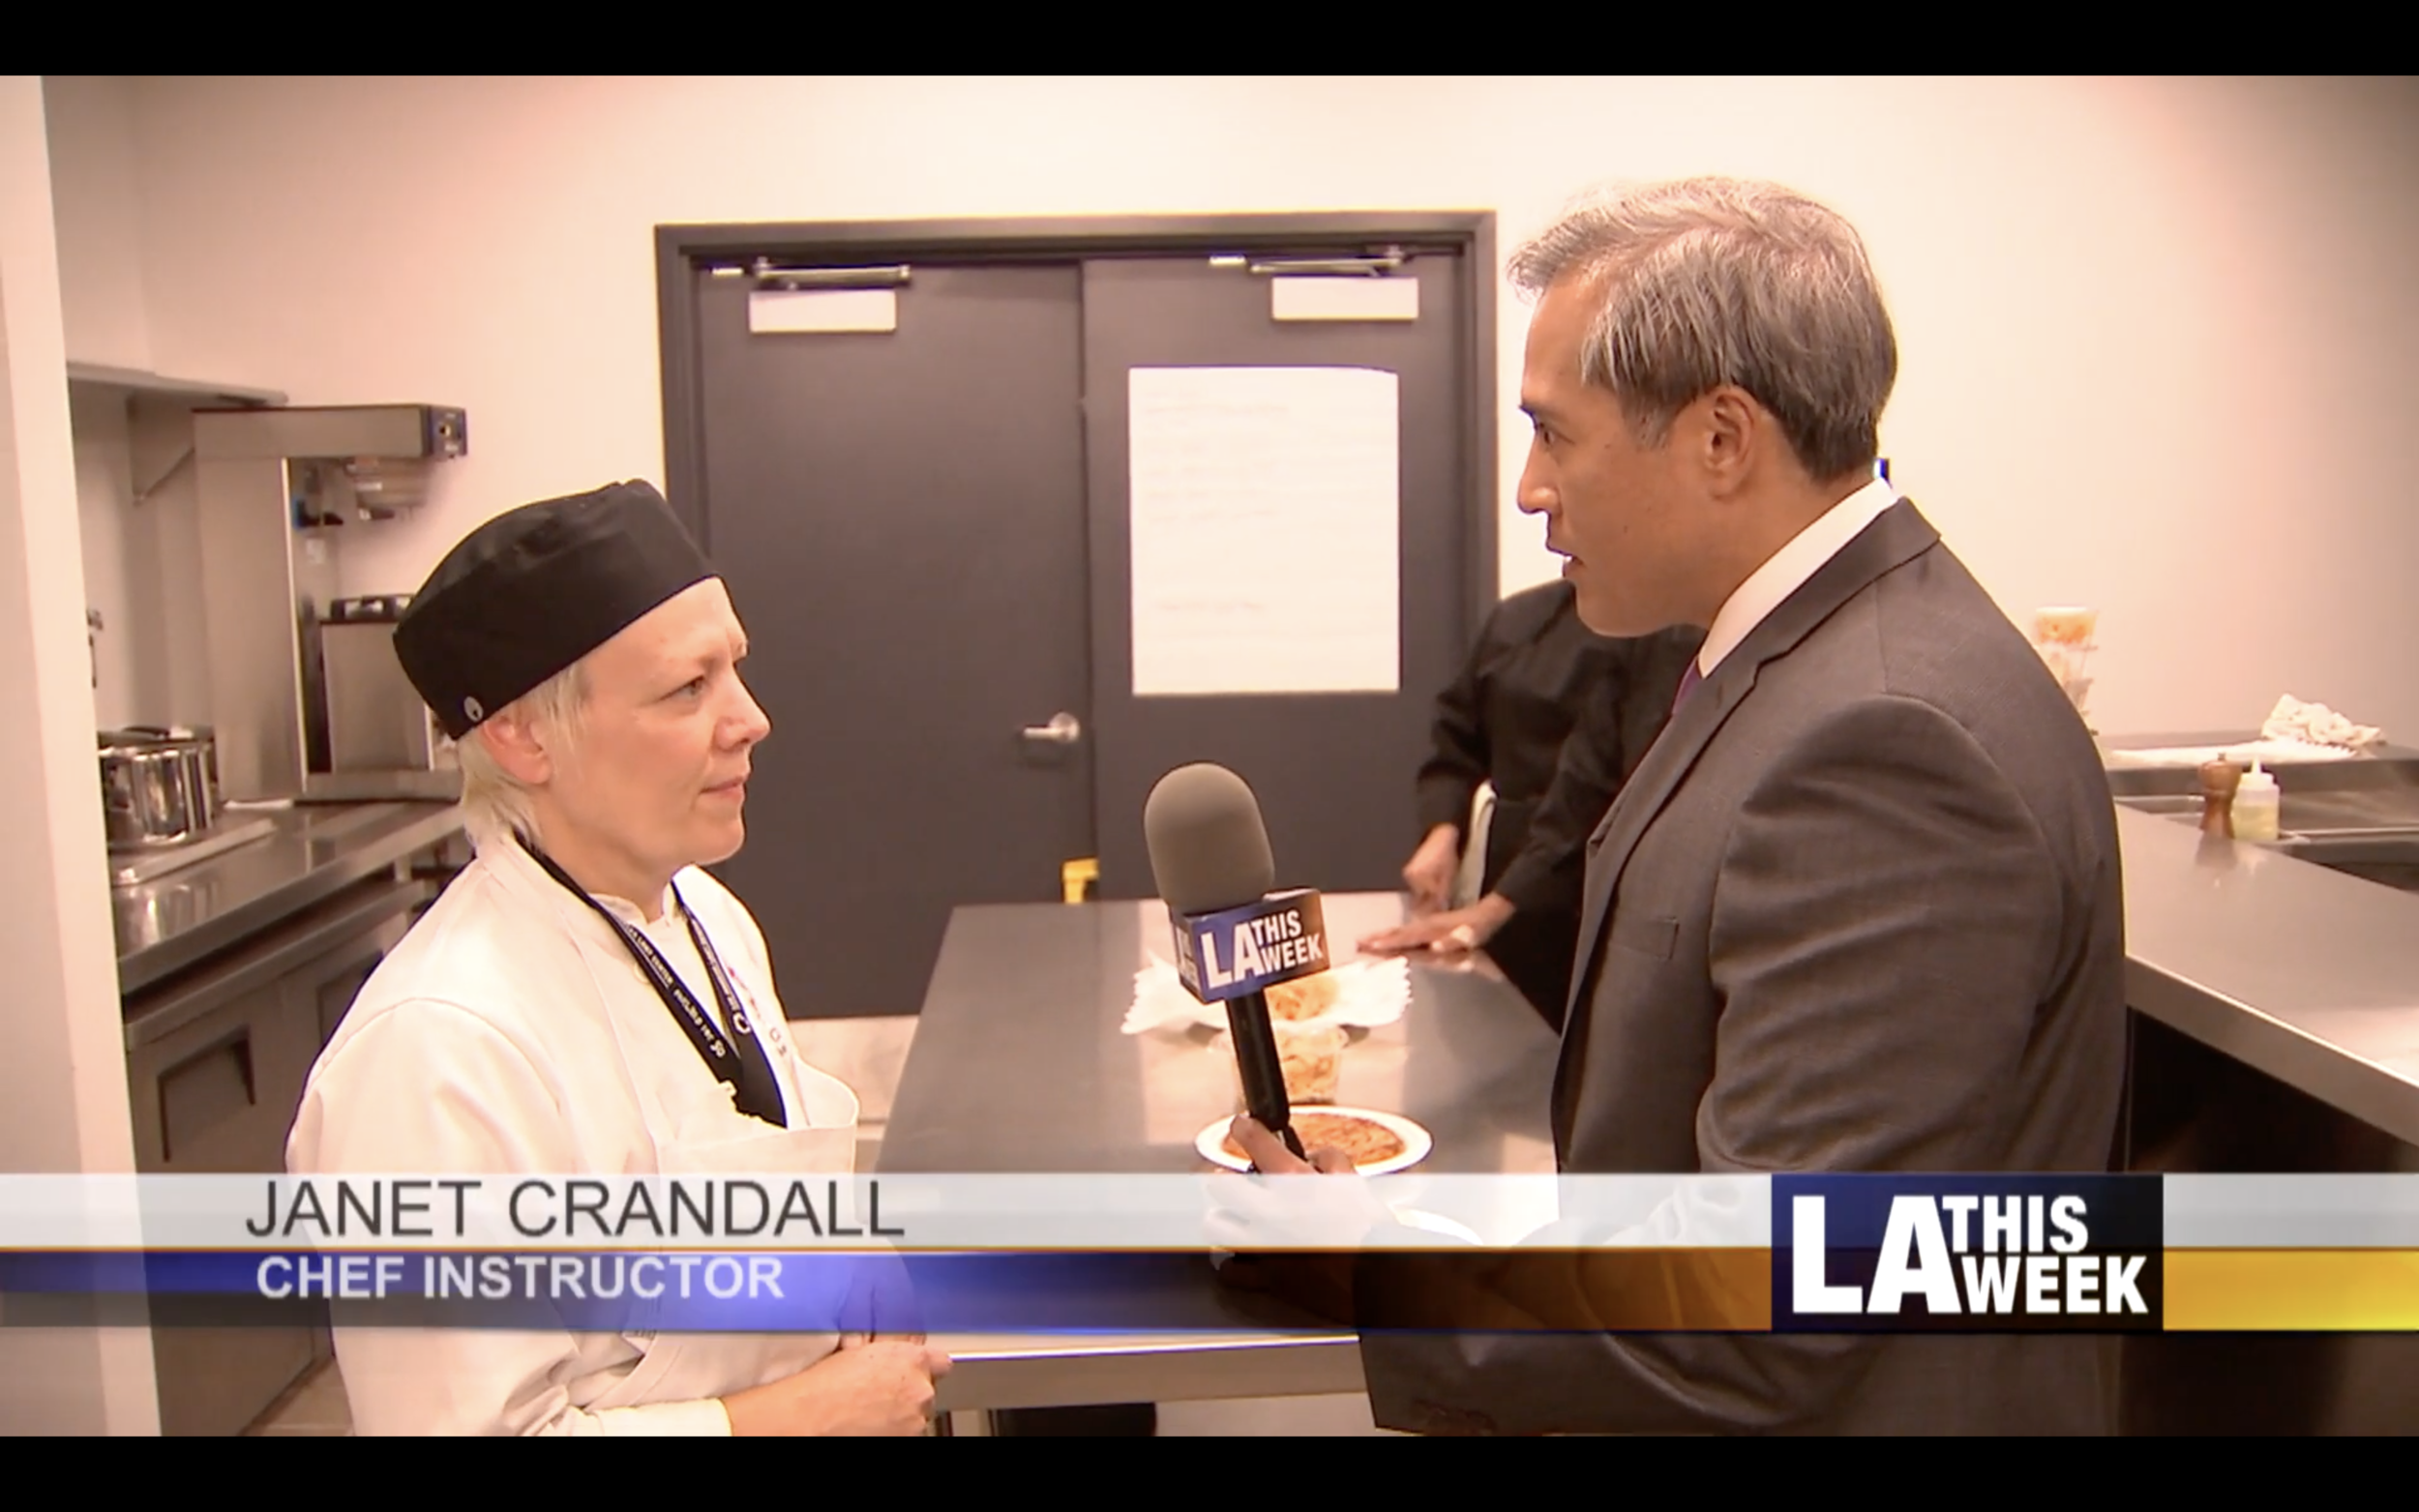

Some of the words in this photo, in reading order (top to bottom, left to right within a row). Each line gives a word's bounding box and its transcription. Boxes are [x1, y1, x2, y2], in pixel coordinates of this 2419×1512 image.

[1201, 923, 1265, 990] LA
[1251, 909, 1301, 946] THIS
[1261, 933, 1323, 973] WEEK
